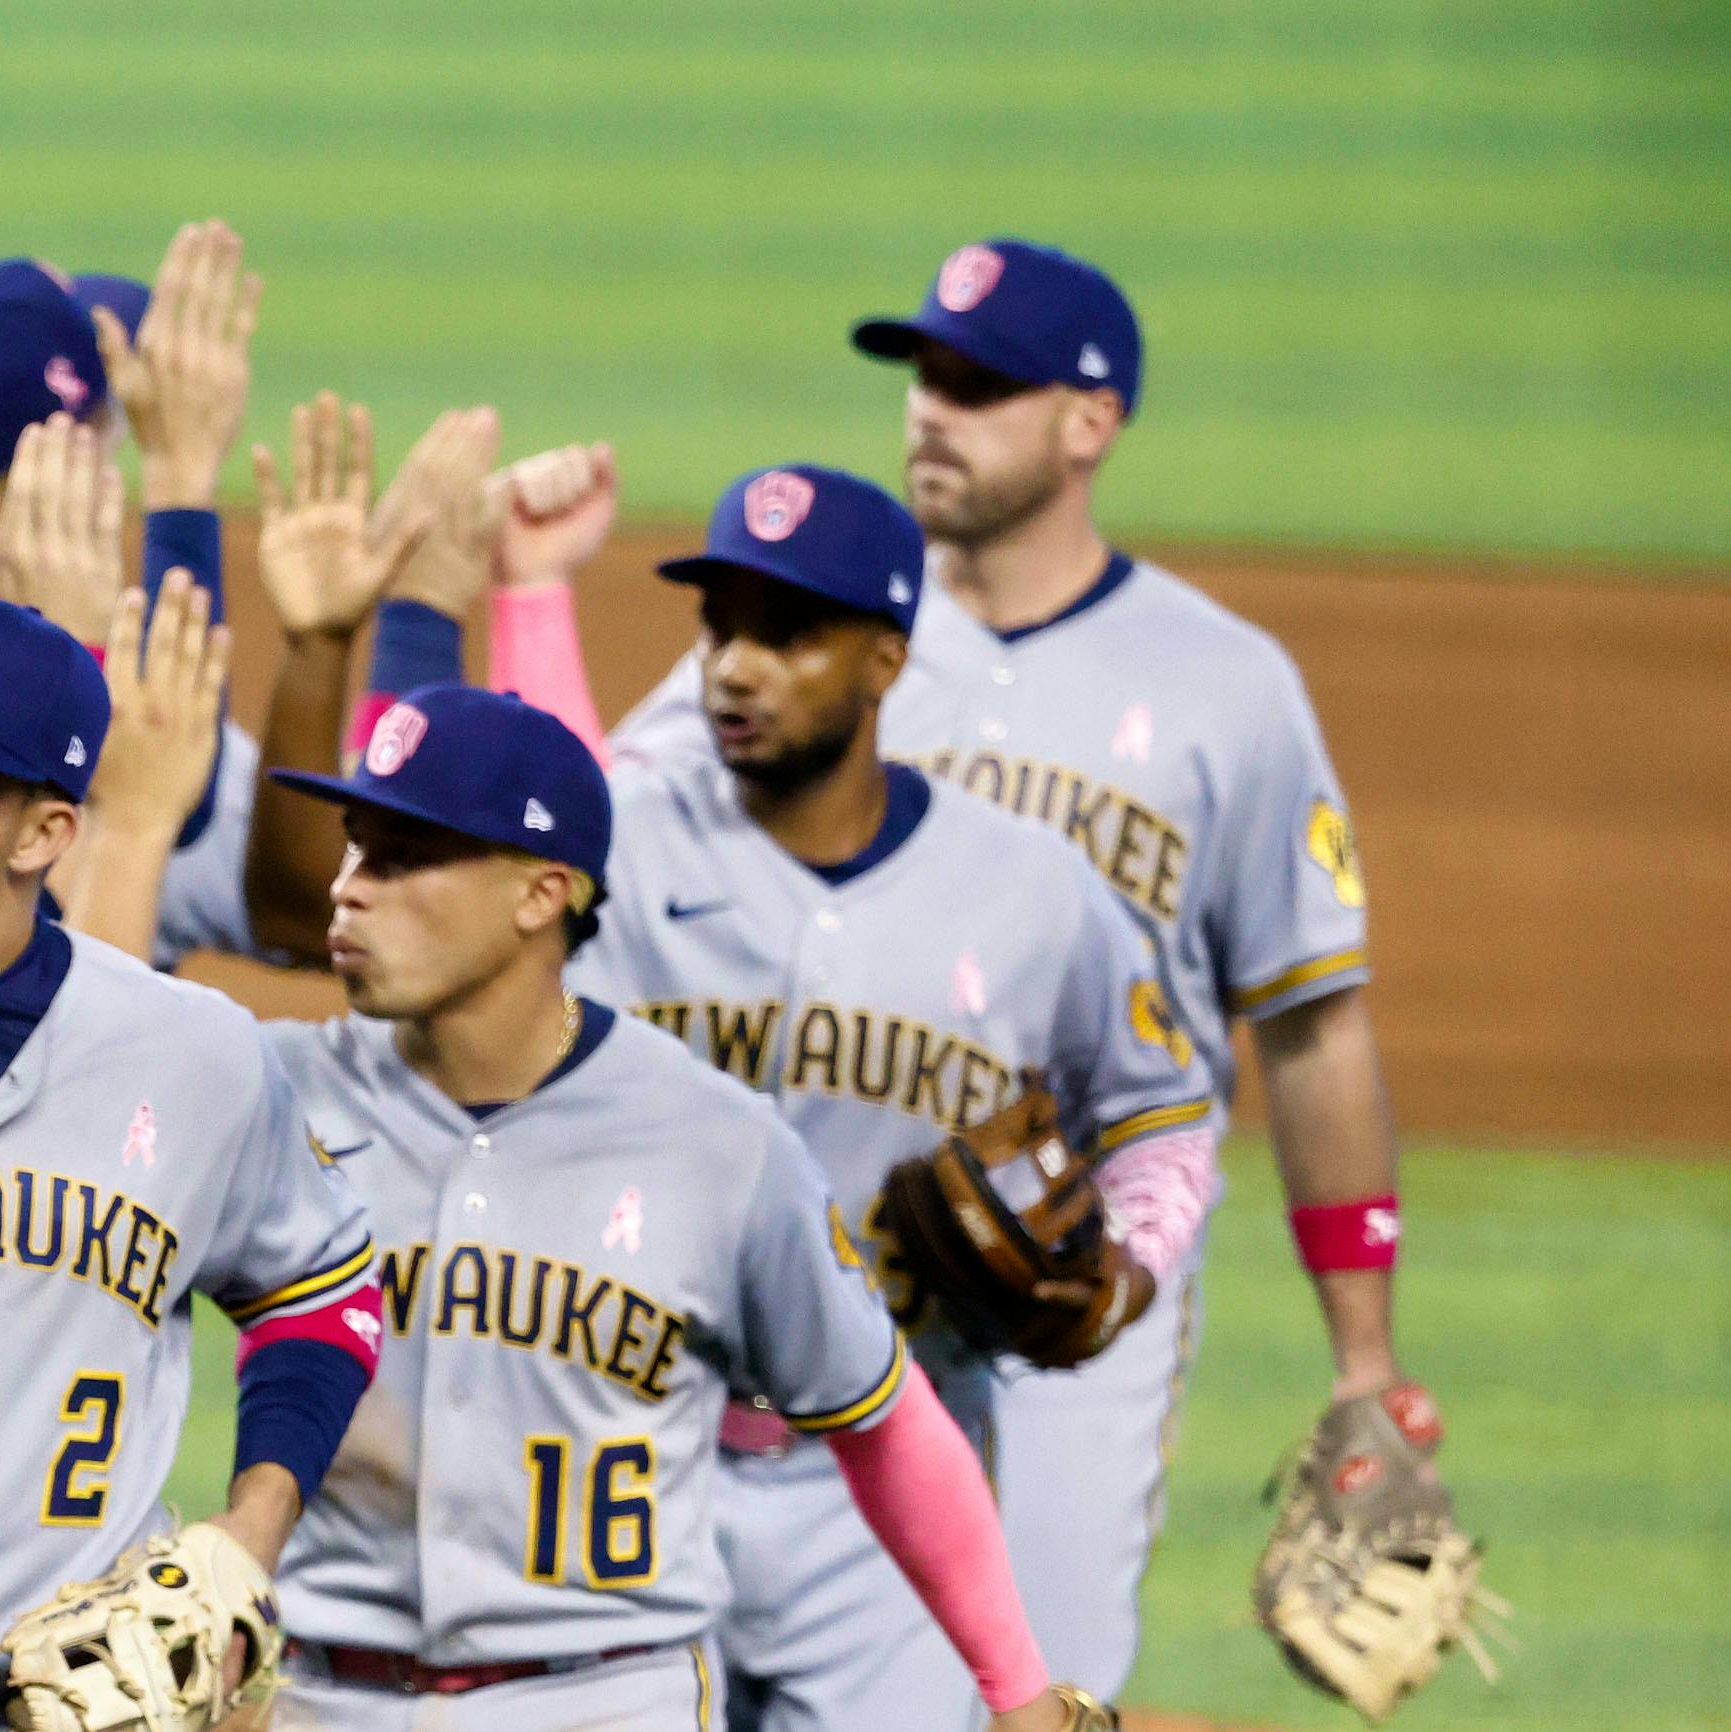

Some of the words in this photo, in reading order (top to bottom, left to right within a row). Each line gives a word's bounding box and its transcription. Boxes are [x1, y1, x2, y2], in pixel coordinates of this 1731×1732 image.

[381, 1240, 686, 1404] WAUKEE
[39, 1368, 127, 1528] 2
[522, 1432, 660, 1592] 16
